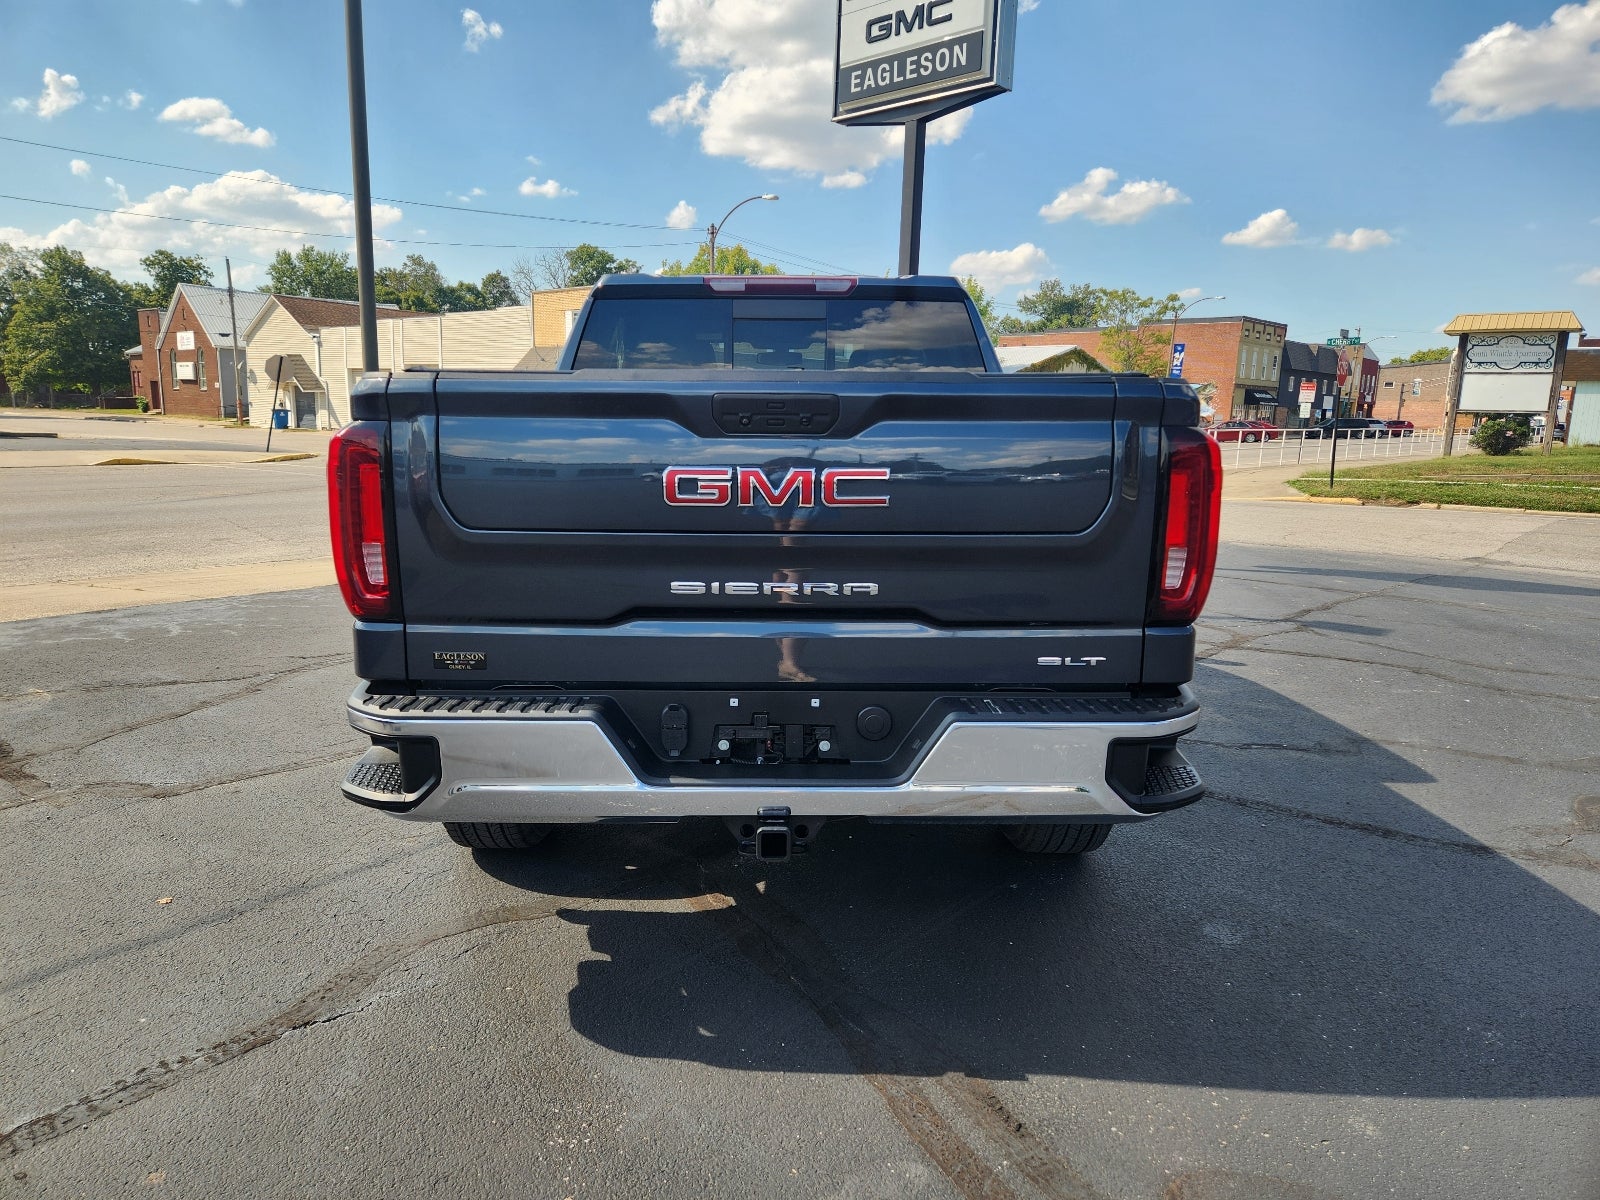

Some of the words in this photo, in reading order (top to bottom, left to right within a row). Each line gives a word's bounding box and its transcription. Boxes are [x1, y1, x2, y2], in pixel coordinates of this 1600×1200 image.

[865, 0, 953, 44] GMC
[850, 42, 968, 94] EAGLESON
[662, 465, 890, 507] GMC
[670, 581, 879, 596] SIERRA
[434, 652, 486, 660] EAGLESON
[1037, 656, 1107, 666] SLT
